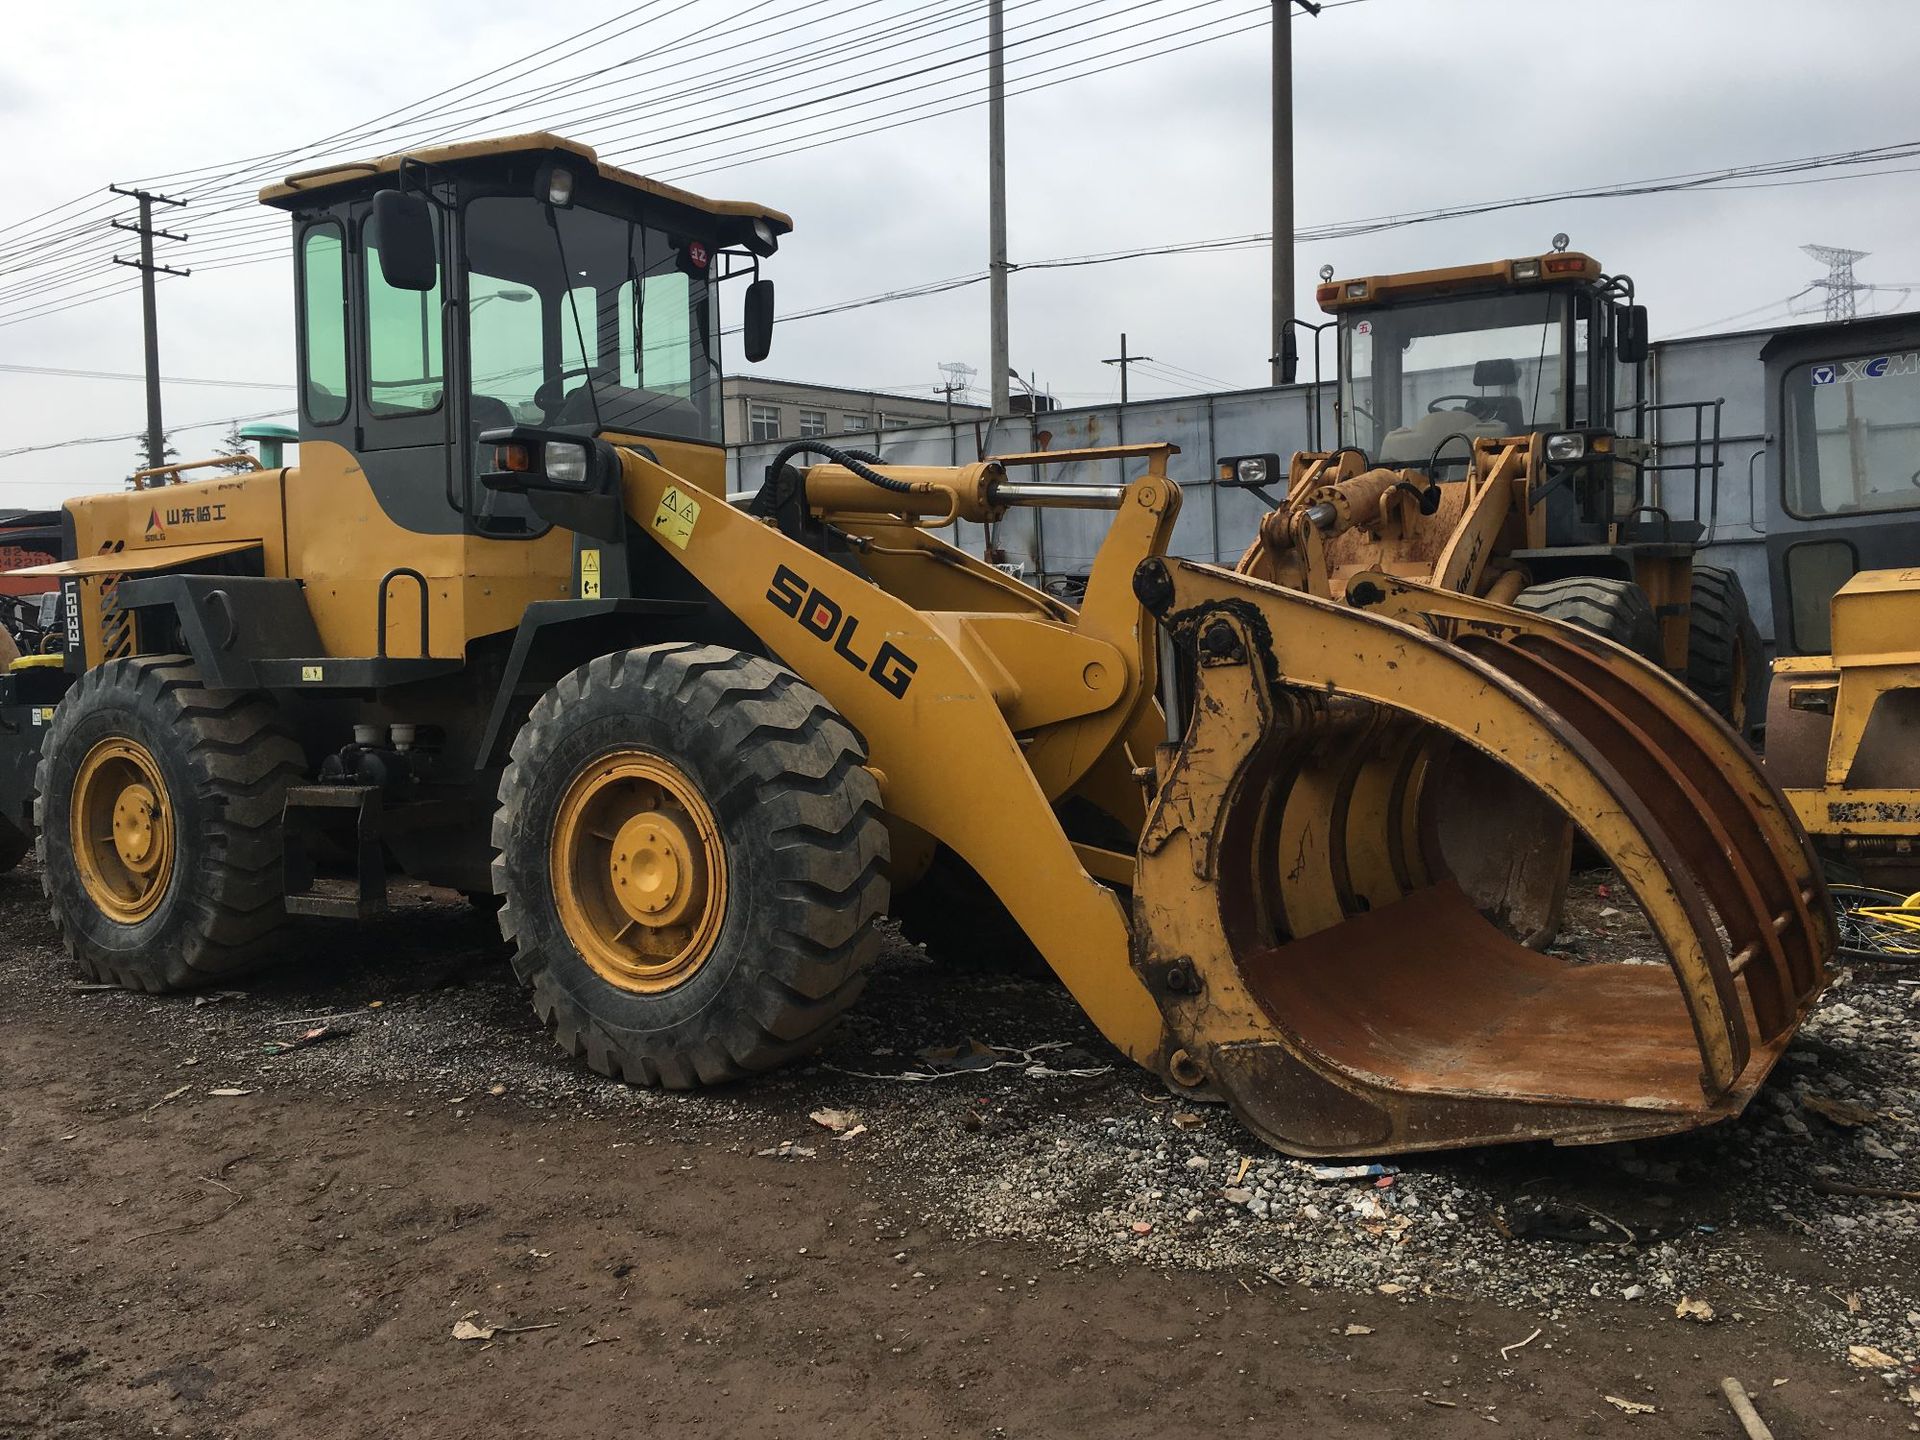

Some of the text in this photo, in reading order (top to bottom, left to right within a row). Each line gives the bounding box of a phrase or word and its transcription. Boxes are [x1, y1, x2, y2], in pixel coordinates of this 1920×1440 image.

[1838, 352, 1920, 383] XCM
[167, 504, 226, 525] 山东临工
[145, 533, 166, 542] SDLG
[65, 581, 80, 653] LG933L
[766, 564, 918, 700] SDLG
